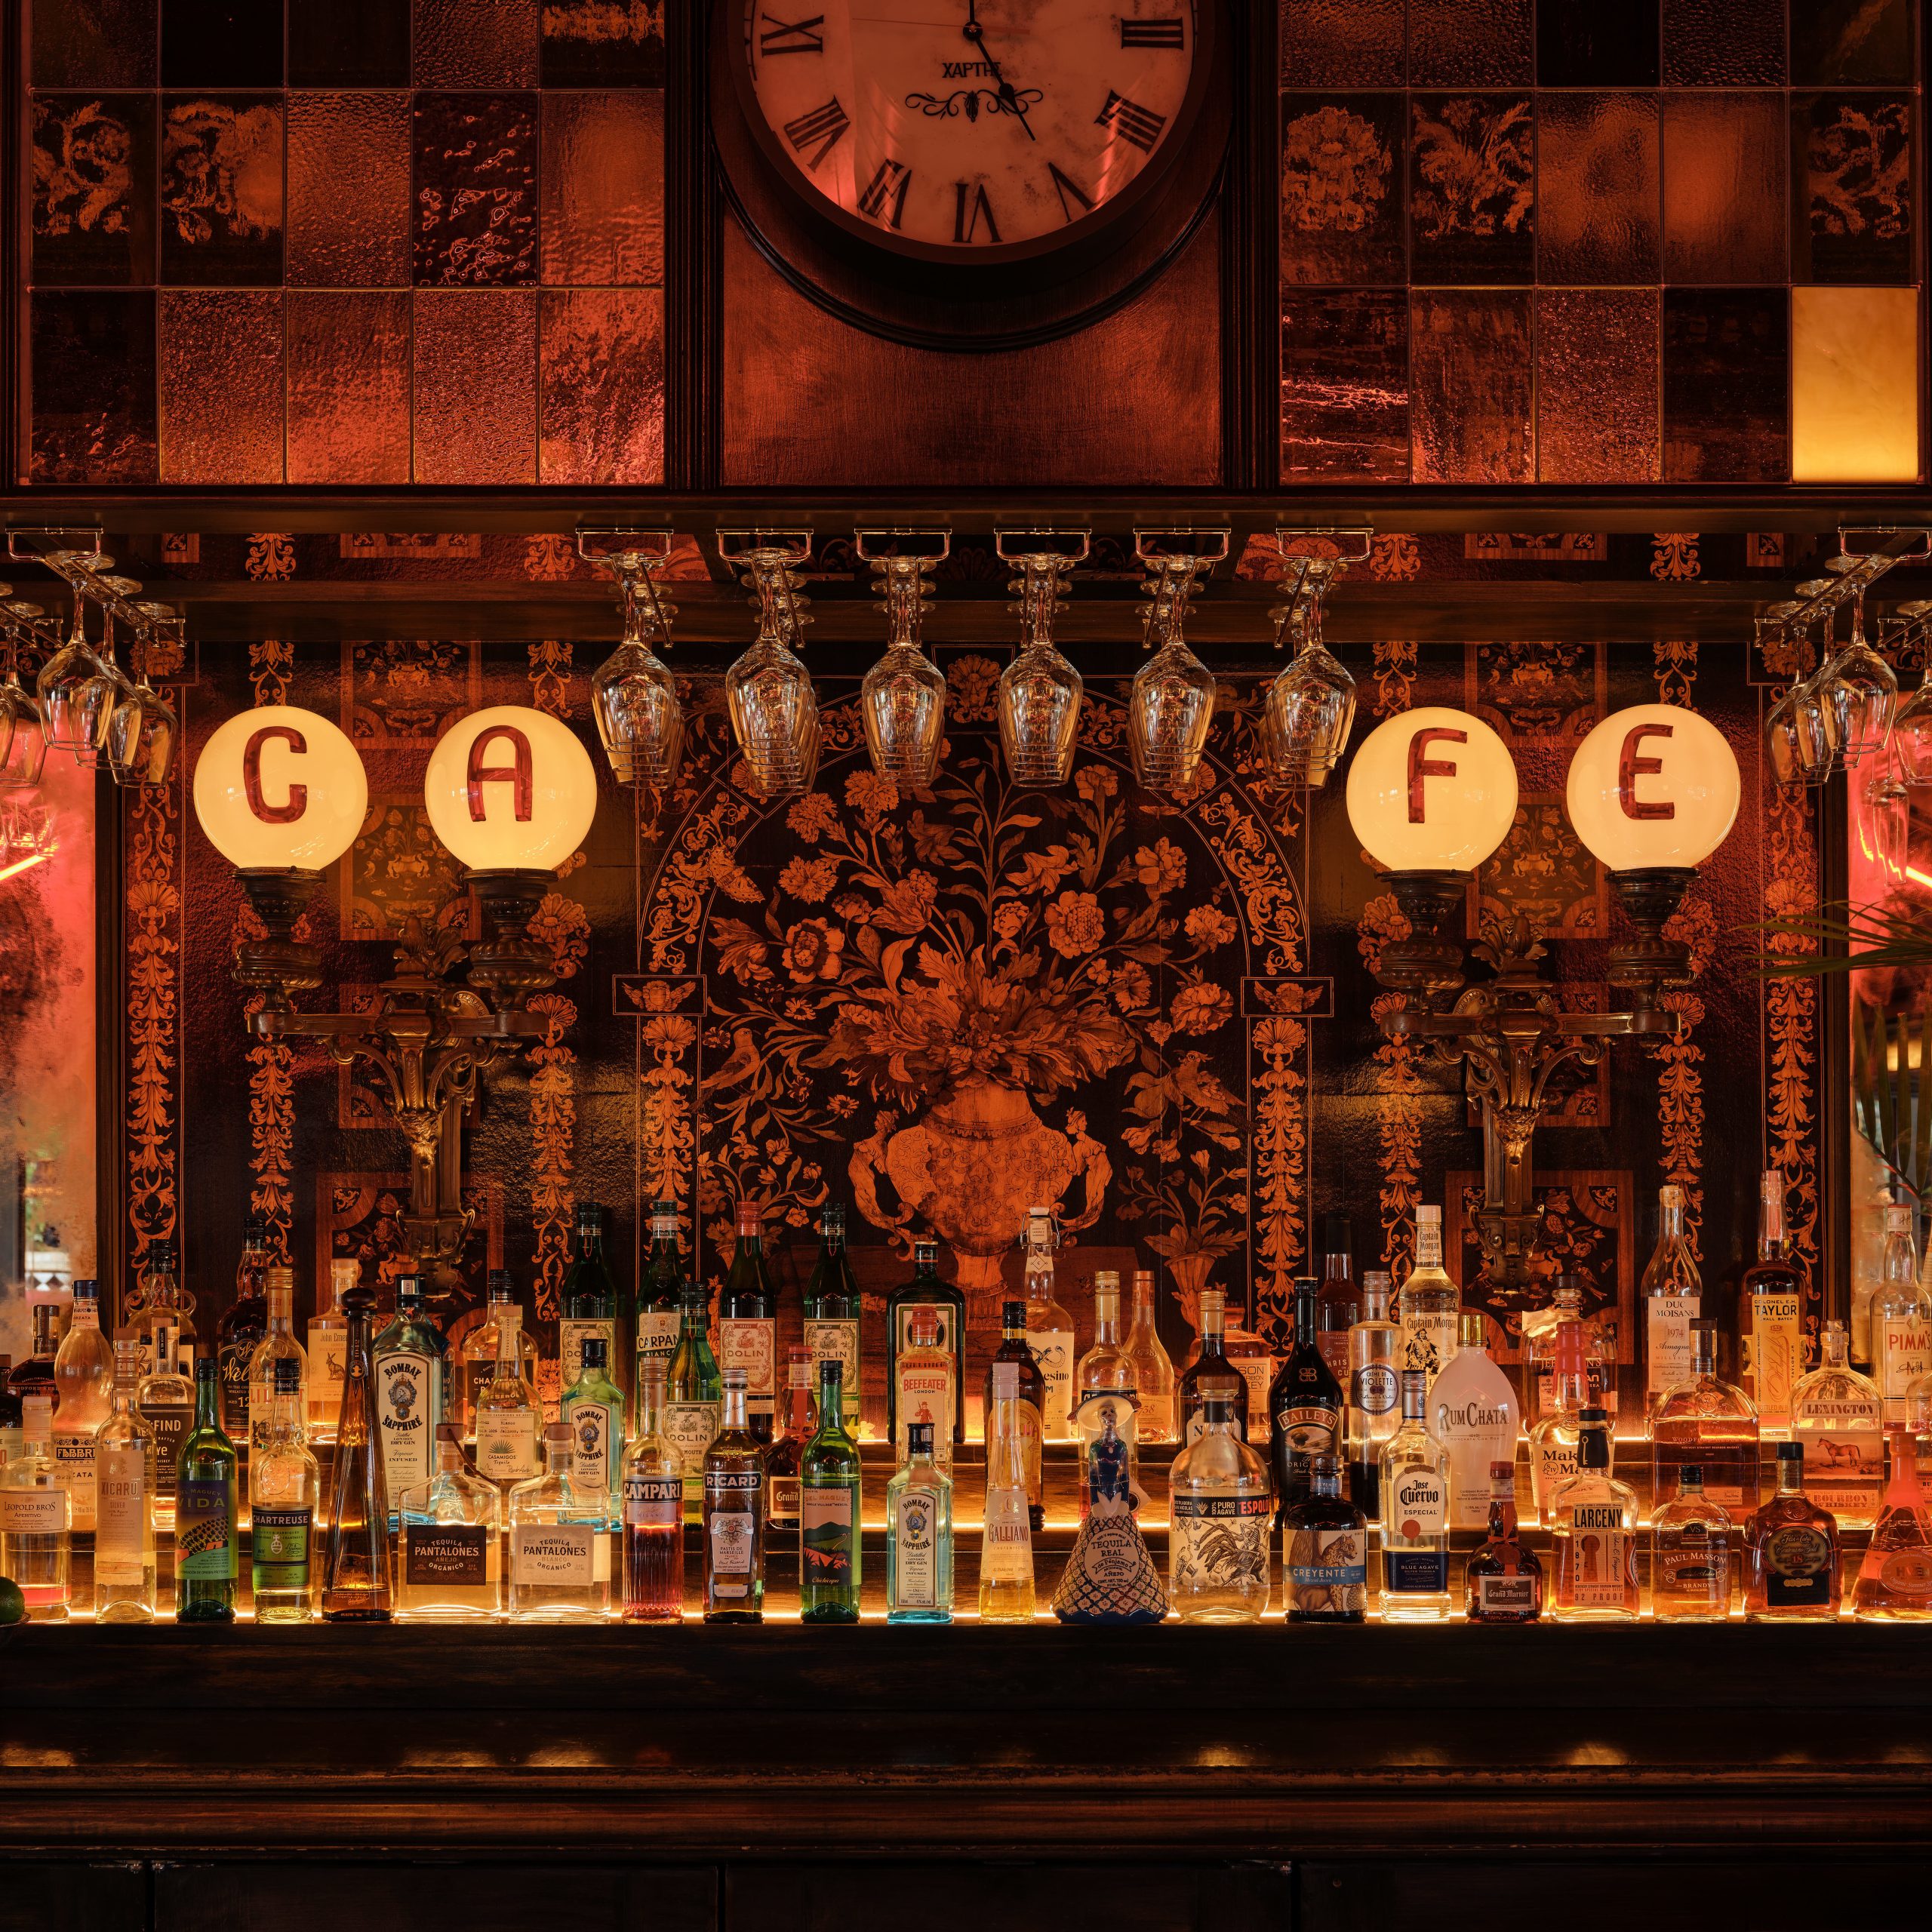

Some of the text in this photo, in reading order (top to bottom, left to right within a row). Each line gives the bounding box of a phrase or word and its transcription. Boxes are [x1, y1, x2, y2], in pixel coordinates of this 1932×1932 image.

[1048, 161, 1096, 223] V
[952, 182, 1003, 244] VI
[243, 723, 1675, 824] C A F E
[1419, 1231, 1438, 1241] Captain
[1419, 1241, 1440, 1251] Morgan
[1666, 1300, 1686, 1309] DUC
[1656, 1309, 1694, 1318] MOISANS
[1754, 1305, 1797, 1316] TAYLOR
[1407, 1316, 1457, 1331] Captain Morgan
[1666, 1328, 1684, 1339] 1974
[638, 1334, 679, 1349] CARPAN
[1889, 1331, 1931, 1351] PIMM'S
[727, 1349, 764, 1358] DOLIN
[383, 1362, 423, 1380] BOMBAY
[1044, 1371, 1069, 1381] esino
[1238, 1366, 1264, 1375] SON
[903, 1378, 946, 1392] BEEFEATER
[1360, 1377, 1393, 1386] VIOLETTE
[1807, 1404, 1873, 1414] LEXINGTON
[575, 1411, 603, 1423] BOMBAY
[1282, 1410, 1336, 1426] BAILEYS
[381, 1414, 423, 1432] SAPPHIRE
[574, 1447, 604, 1460] SAPPHIRE
[706, 1475, 757, 1487] RICARD
[1413, 1479, 1429, 1491] Jose
[623, 1482, 681, 1500] CAMPARI
[1400, 1487, 1438, 1506] Cuervo
[175, 1497, 226, 1509] VIDA
[1814, 1494, 1868, 1503] BOURBON
[4, 1501, 35, 1511] LEOPOLD
[36, 1501, 56, 1511] BROS
[903, 1499, 930, 1512] BOMBAY
[253, 1514, 309, 1525] CHARTREUSE
[1574, 1509, 1623, 1528] LARCENY
[989, 1523, 1028, 1543] GALLIANO
[431, 1539, 463, 1547] TEQUILA
[539, 1538, 571, 1547] TEQUILA
[900, 1538, 931, 1550] SAPPHIRE
[1091, 1540, 1132, 1549] TEQUILA
[1781, 1534, 1796, 1545] Flor
[414, 1546, 479, 1556] PANTALONES
[523, 1546, 587, 1556] PANTALONES
[1104, 1559, 1128, 1567] Pénjamo
[1664, 1552, 1726, 1565] PAUL MASSON
[1793, 1555, 1804, 1564] 18
[1293, 1568, 1346, 1577] CREYENTE
[1487, 1589, 1529, 1598] Grand Marnier
[1574, 1592, 1623, 1601] 92 PROOF
